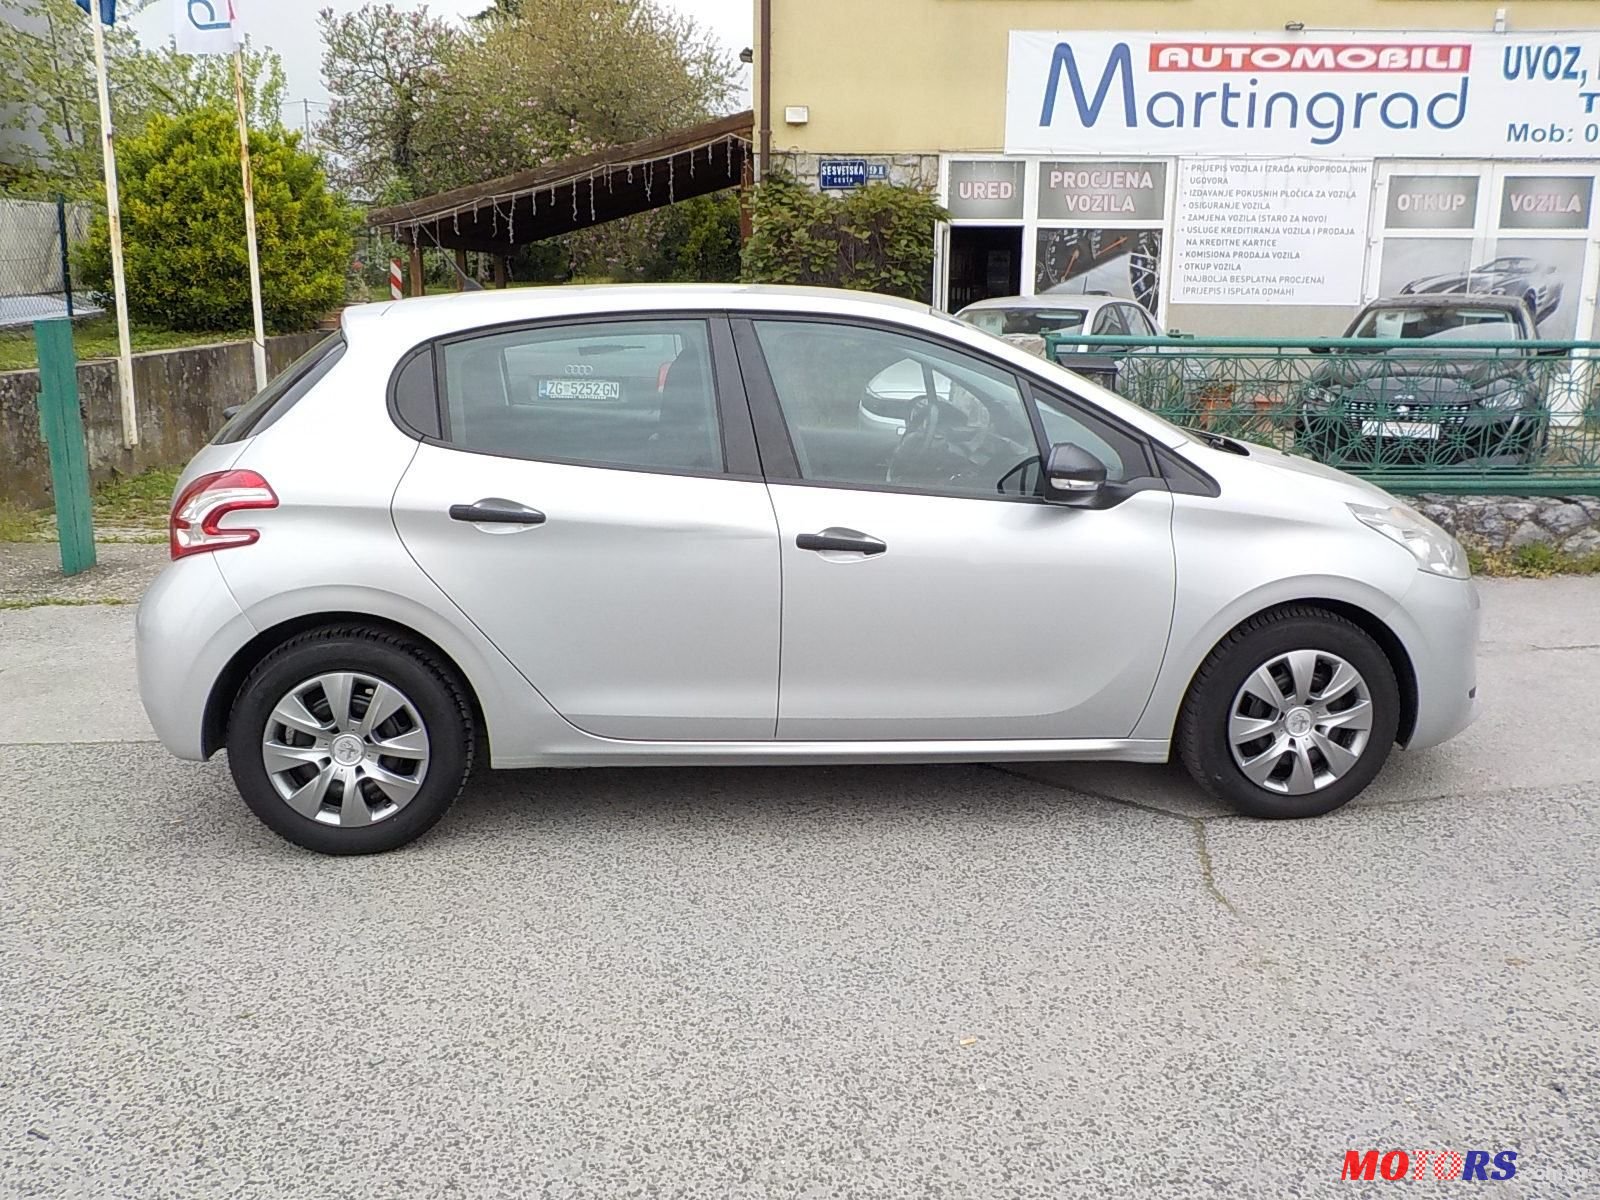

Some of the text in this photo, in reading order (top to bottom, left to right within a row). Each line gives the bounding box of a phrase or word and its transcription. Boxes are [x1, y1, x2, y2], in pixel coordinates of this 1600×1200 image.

[1158, 47, 1462, 69] AUTOMOBILI
[1503, 45, 1587, 88] UVOZ,
[1039, 43, 1469, 145] Martingrad
[1507, 123, 1573, 142] Mob:
[822, 166, 864, 176] SESVETSKA
[1050, 171, 1153, 189] PROCJENA
[960, 182, 1012, 199] URED
[1066, 194, 1136, 212] VOZILA
[1397, 194, 1466, 211] OTKUP
[1510, 194, 1582, 212] VOZILA
[548, 382, 562, 394] ZG
